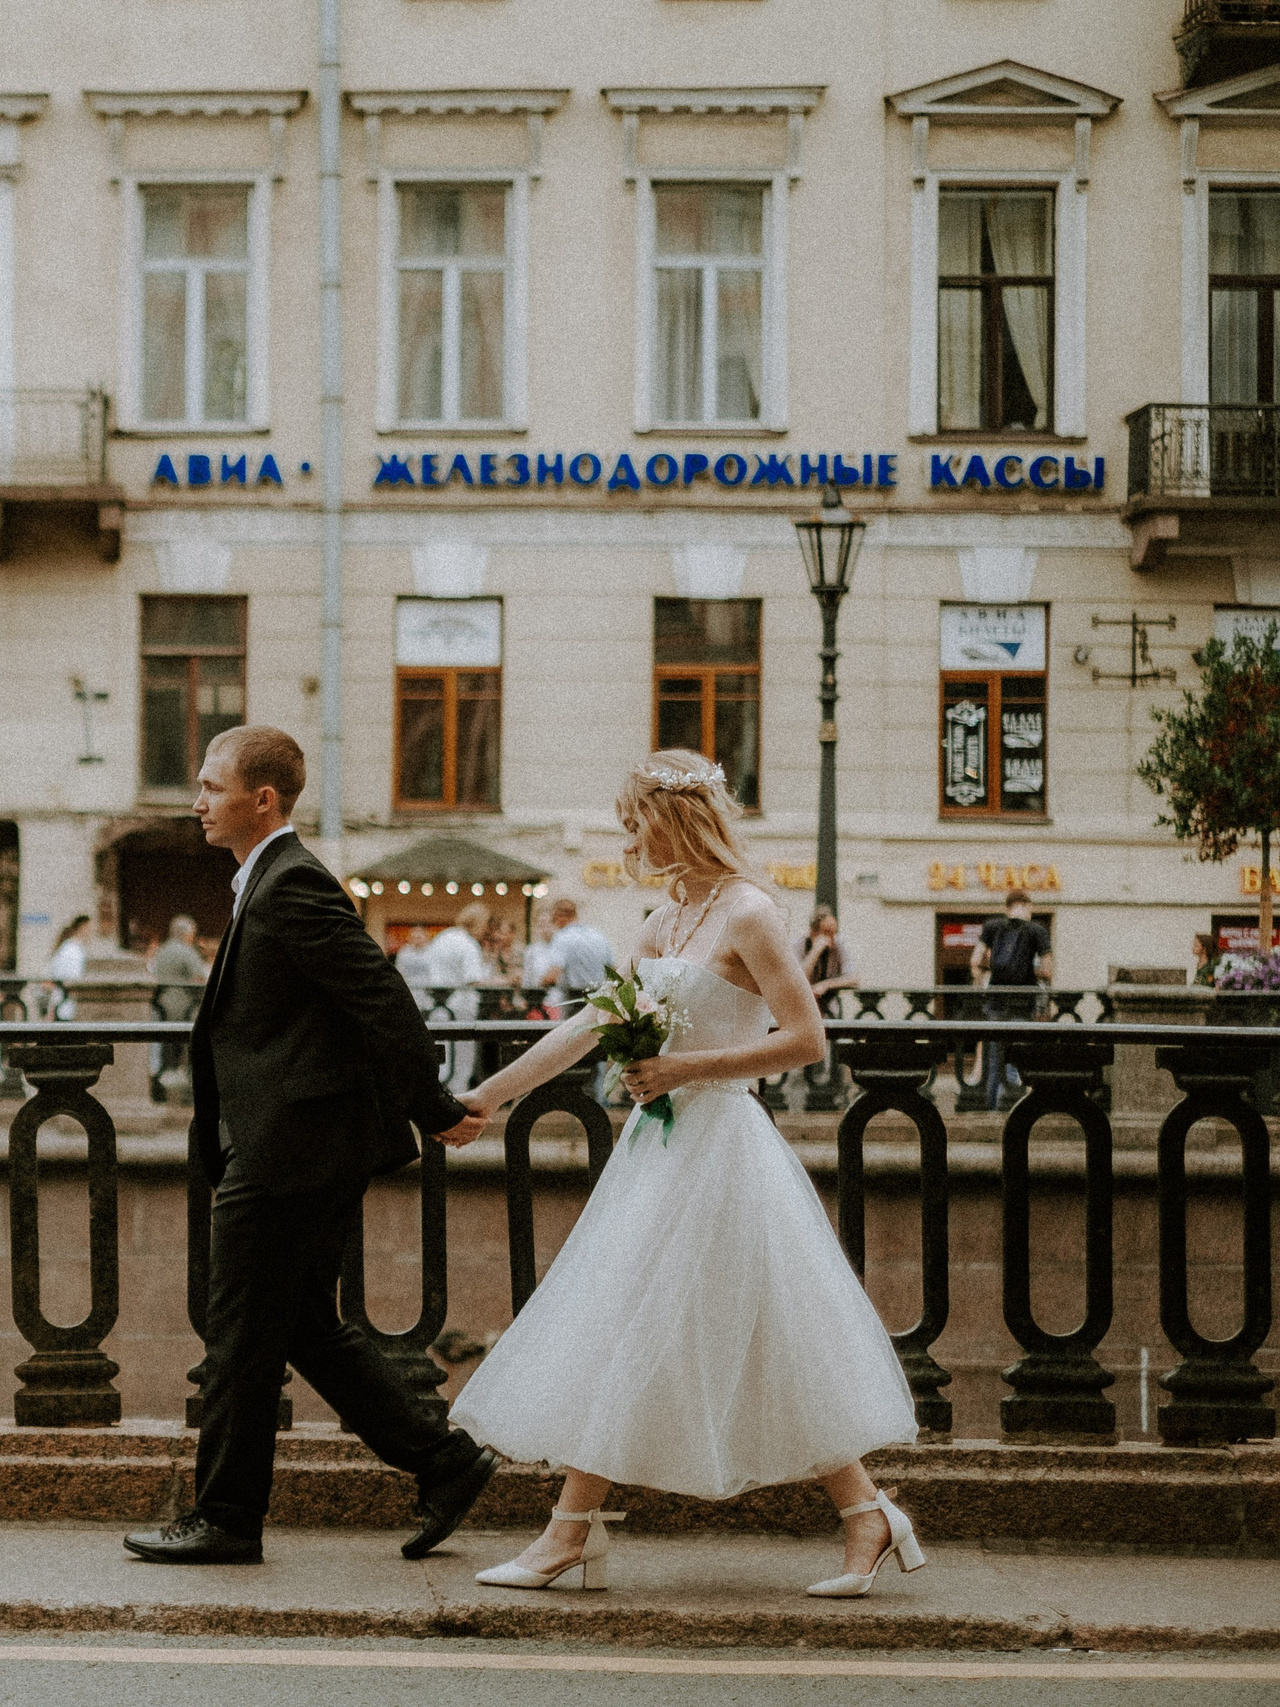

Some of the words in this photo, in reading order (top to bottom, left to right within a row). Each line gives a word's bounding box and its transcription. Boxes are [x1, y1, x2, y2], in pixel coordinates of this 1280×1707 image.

[152, 452, 284, 486] АВИА
[373, 452, 897, 491] ЖЕЛЕЗНОДОРОЖНЫЕ
[929, 453, 1106, 489] КАССЫ
